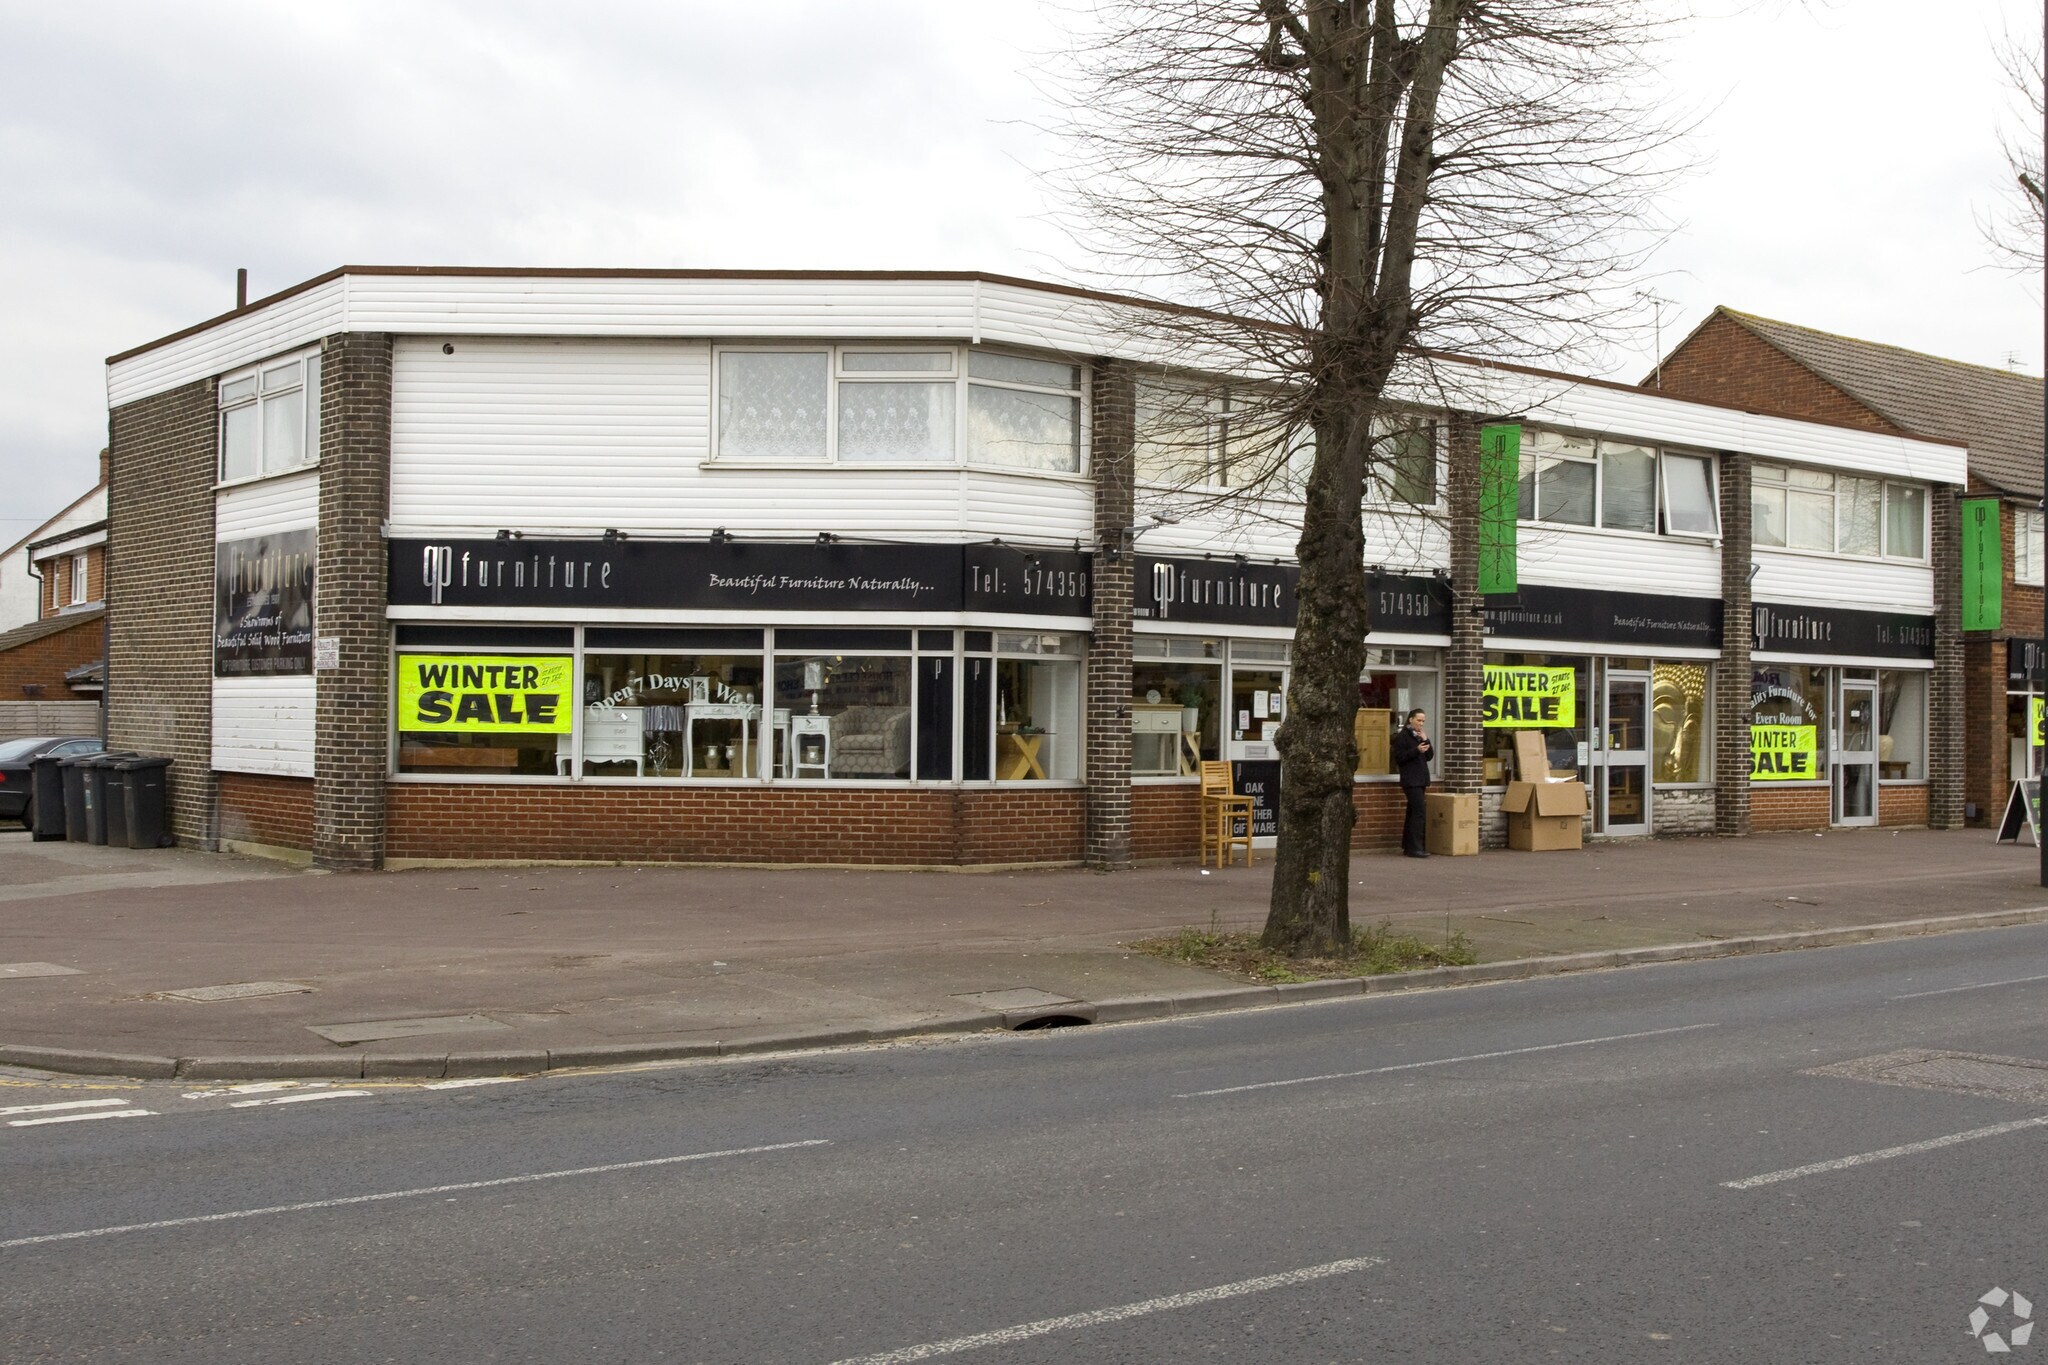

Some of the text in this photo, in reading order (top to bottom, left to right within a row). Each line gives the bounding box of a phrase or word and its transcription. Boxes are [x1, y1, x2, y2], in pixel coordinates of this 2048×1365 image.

[241, 549, 307, 593] furniture
[462, 551, 610, 588] furniture
[973, 566, 1086, 597] Tel: 574358
[710, 574, 776, 594] Beautiful
[780, 576, 845, 589] Furniture
[1180, 570, 1281, 608] furniture
[1381, 592, 1428, 616] 574358
[1484, 610, 1562, 624] ww.qpfurniture.co.uk
[1614, 615, 1645, 632] Beautiful
[1646, 618, 1676, 629] Furniture
[1771, 612, 1831, 641] furniture
[217, 633, 246, 656] Beautiful
[248, 632, 262, 649] Solid
[282, 631, 311, 646] Furniture
[1877, 625, 1930, 646] Tel: 574358
[418, 664, 539, 689] WINTER
[1483, 672, 1549, 692] WINTER
[418, 691, 560, 724] SALE
[589, 686, 633, 717] Open
[634, 677, 643, 692] 7
[648, 674, 690, 692] Days
[696, 678, 709, 692] A
[1750, 685, 1817, 720] ality Furniture For
[1483, 695, 1560, 722] SALE
[1755, 712, 1802, 725] Every Room
[1245, 783, 1264, 793] OAK
[1234, 822, 1276, 833] GIFWARE
